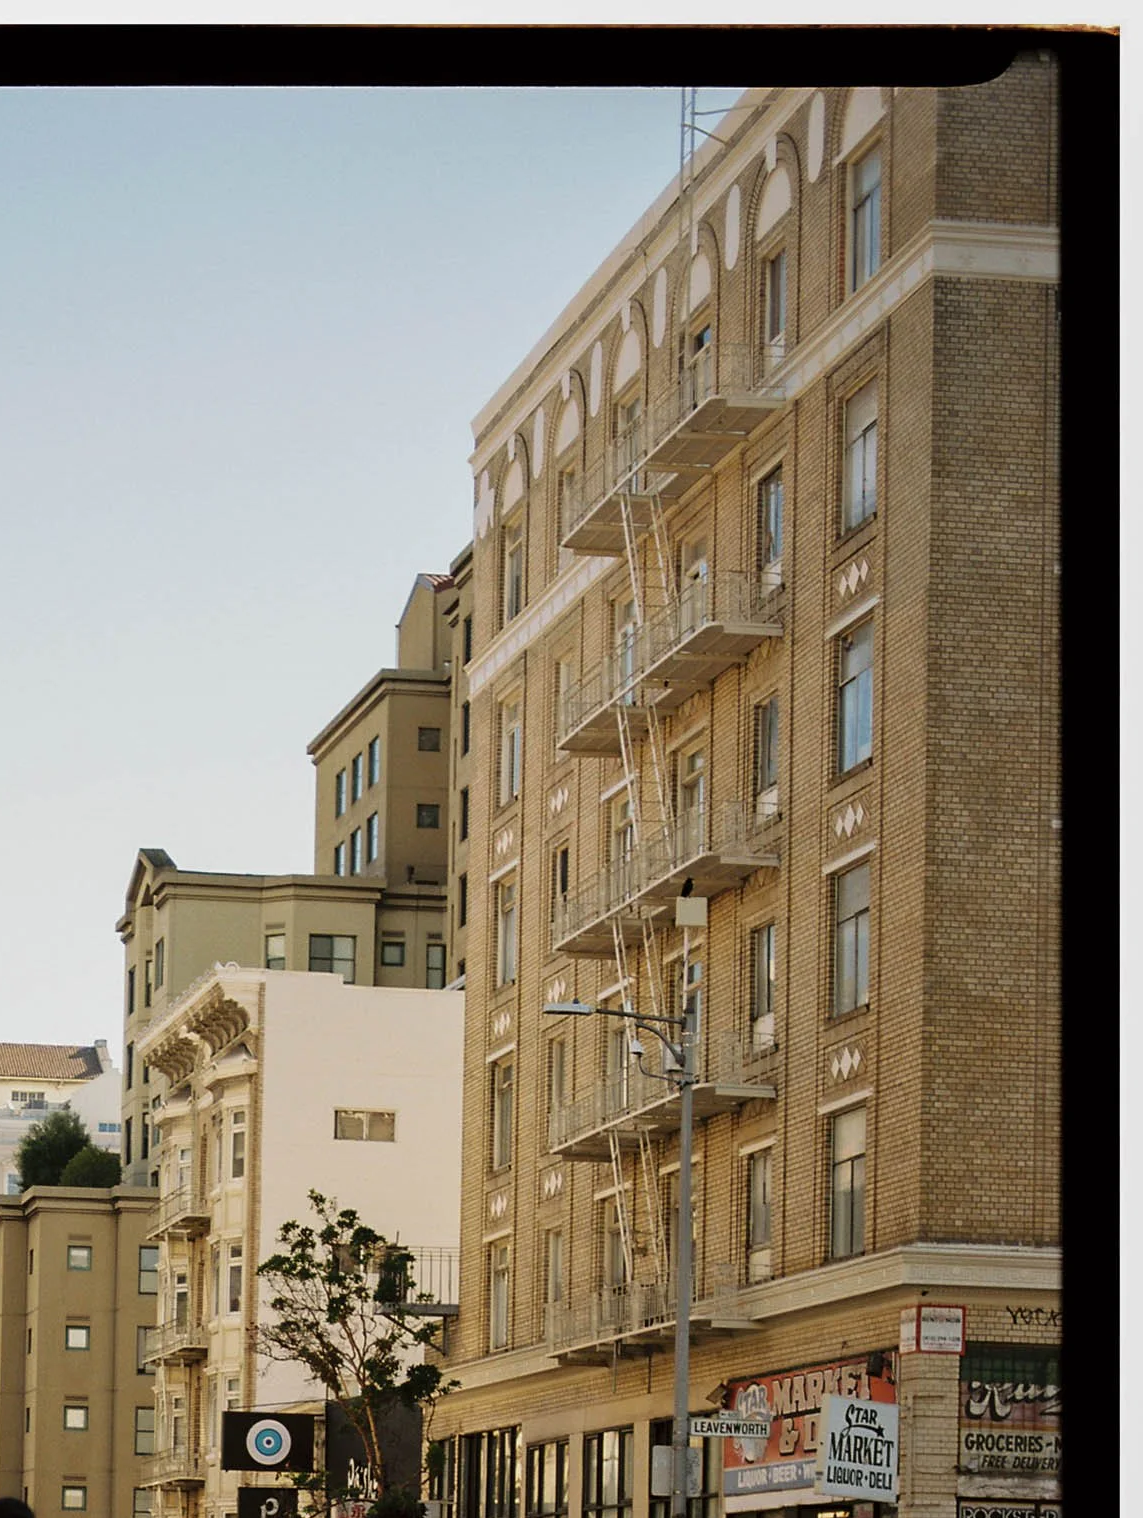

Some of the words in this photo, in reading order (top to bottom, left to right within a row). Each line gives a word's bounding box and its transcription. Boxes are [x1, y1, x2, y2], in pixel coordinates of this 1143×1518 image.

[694, 1421, 767, 1435] LEAVENWORTH
[845, 1403, 878, 1437] STAR
[828, 1432, 894, 1468] MARKET
[964, 1432, 1044, 1452] GROCERIES
[980, 1454, 1008, 1468] FREE
[826, 1465, 862, 1487] LIQUOR
[868, 1471, 892, 1490] DELI
